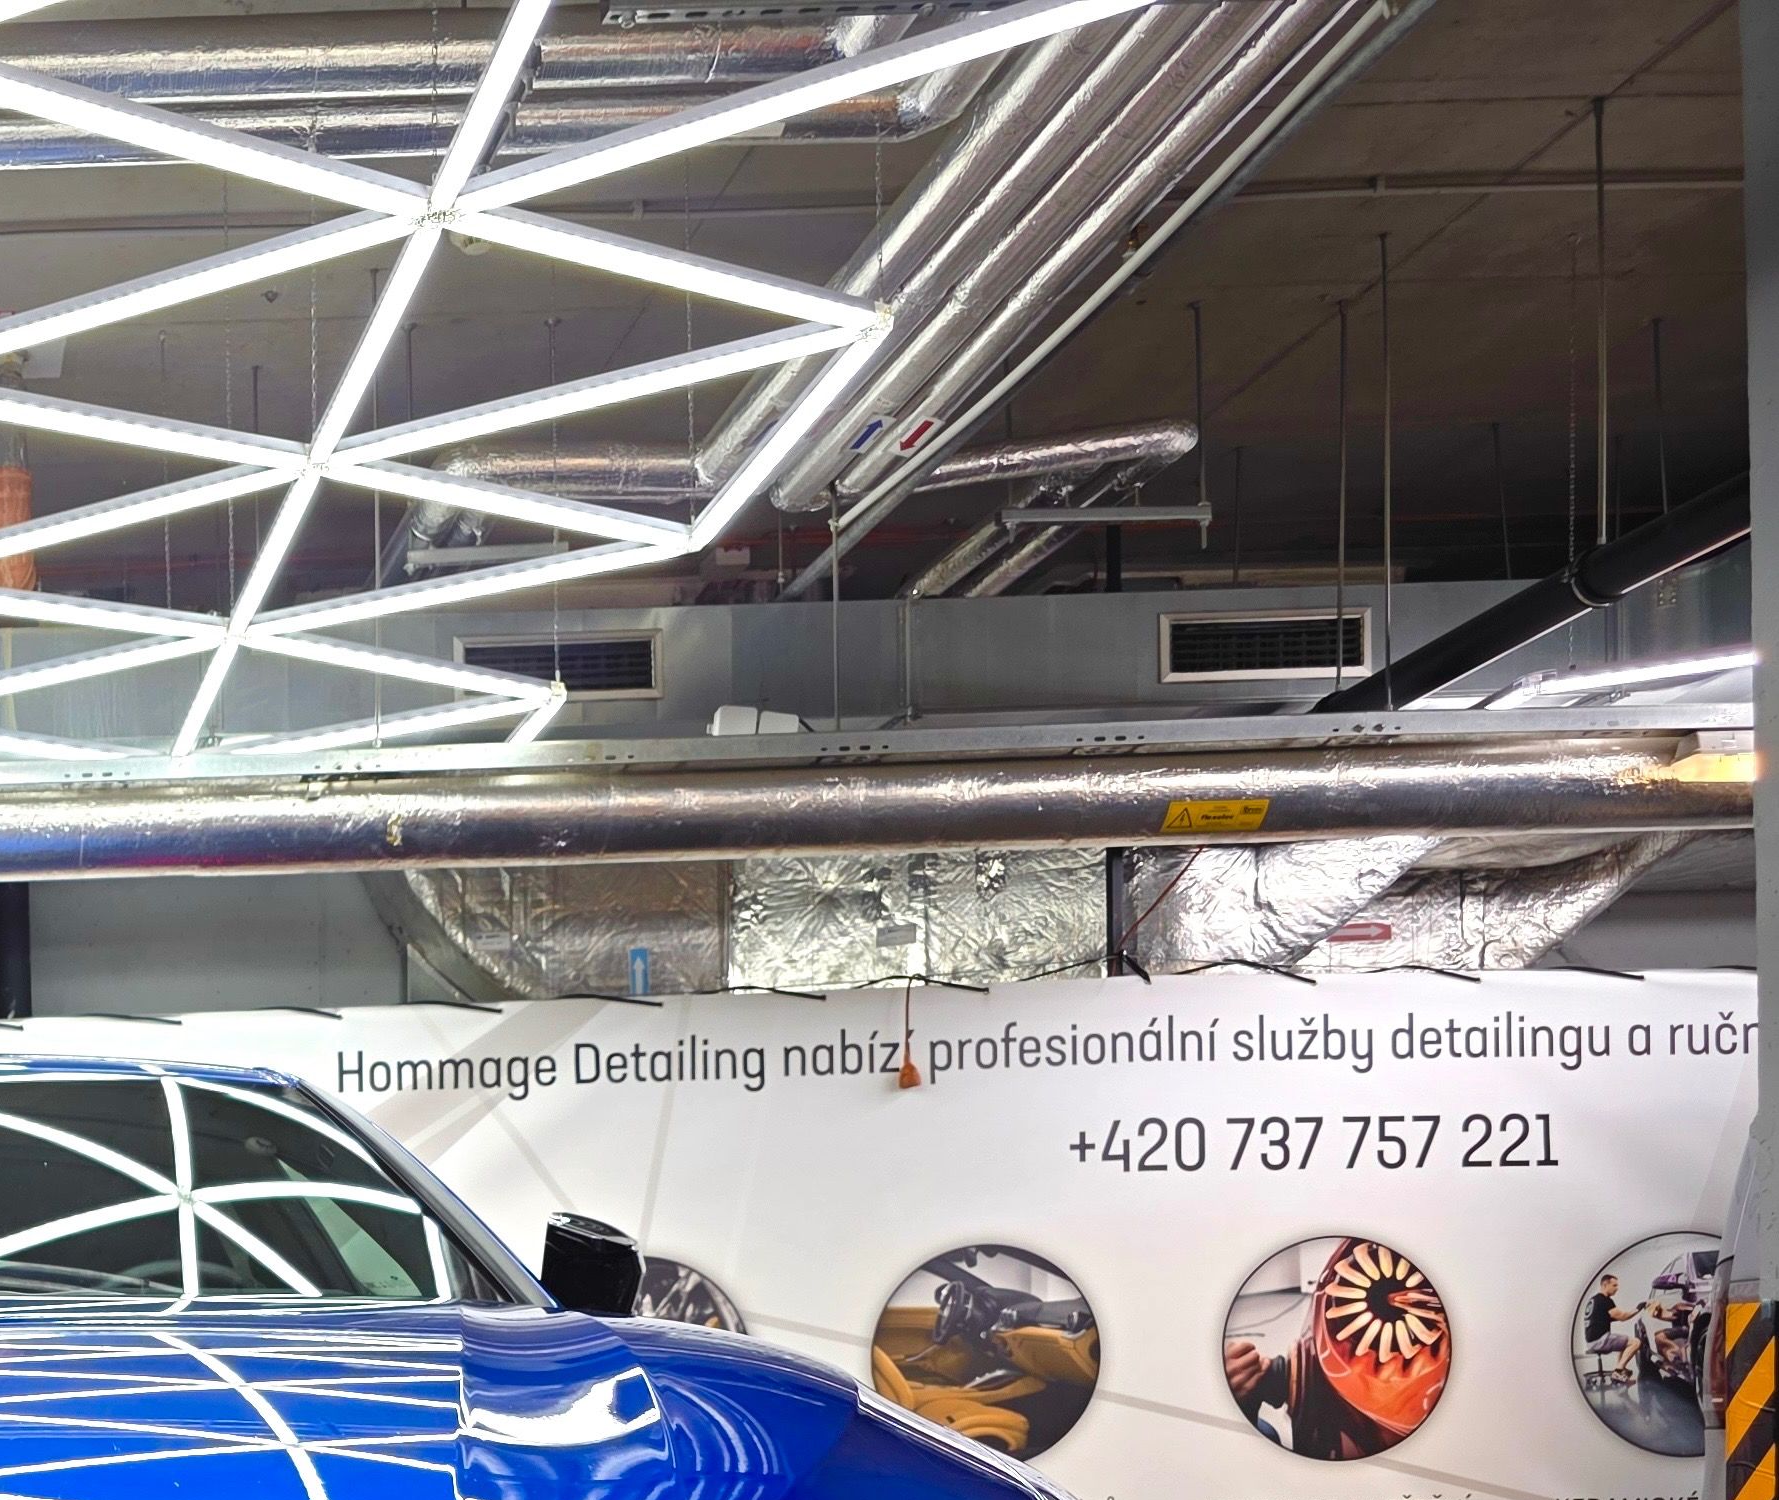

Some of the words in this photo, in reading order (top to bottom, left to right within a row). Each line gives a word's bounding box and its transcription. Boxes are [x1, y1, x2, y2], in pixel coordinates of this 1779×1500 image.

[337, 1051, 557, 1100] Hommage
[574, 1034, 766, 1092] Detailing
[928, 1014, 1217, 1085] profesionální
[1232, 1014, 1374, 1073] služby
[1391, 1010, 1611, 1071] detailingu
[1628, 1025, 1651, 1056] a
[1069, 1117, 1206, 1172] +420
[1226, 1116, 1324, 1171] 737
[1342, 1115, 1441, 1170] 757
[1461, 1113, 1559, 1168] 221
